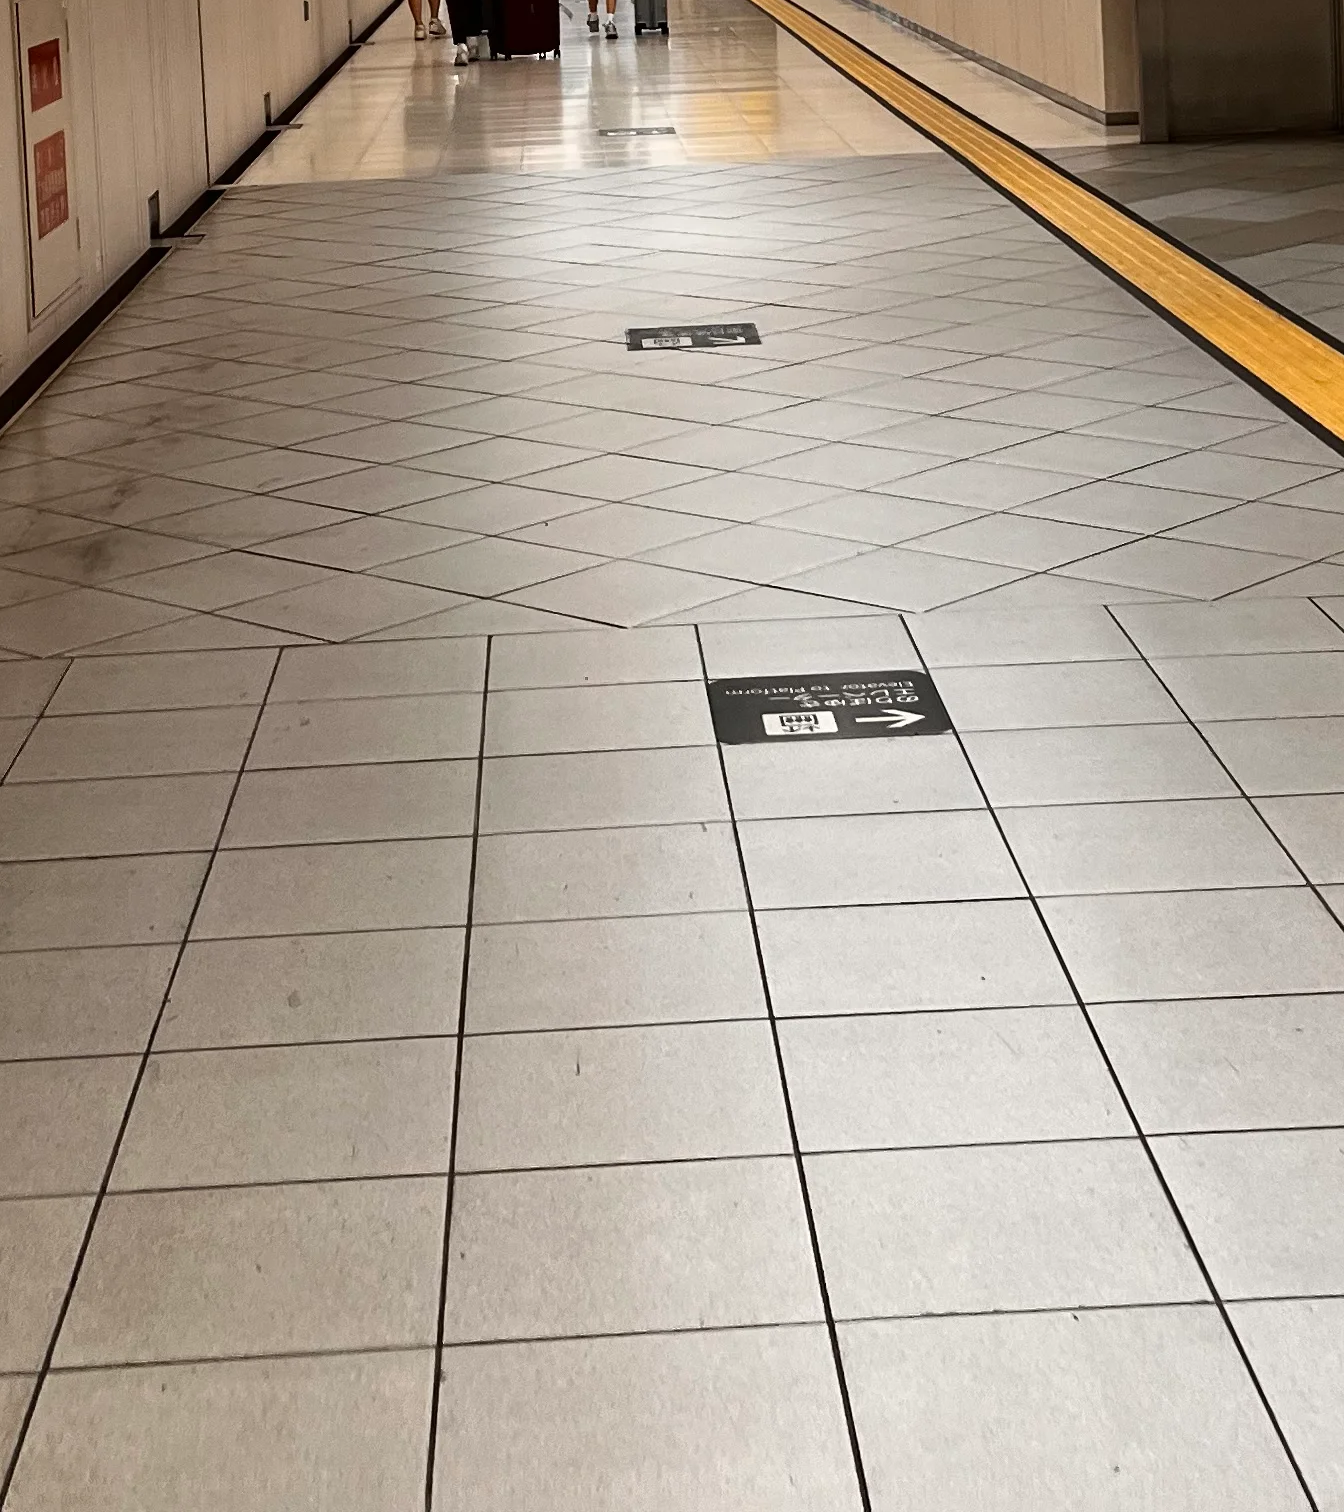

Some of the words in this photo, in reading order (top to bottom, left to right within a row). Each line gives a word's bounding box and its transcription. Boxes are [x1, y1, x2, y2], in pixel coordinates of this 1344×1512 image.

[725, 685, 806, 696] Platform
[811, 684, 830, 692] to
[842, 679, 914, 691] Elevator
